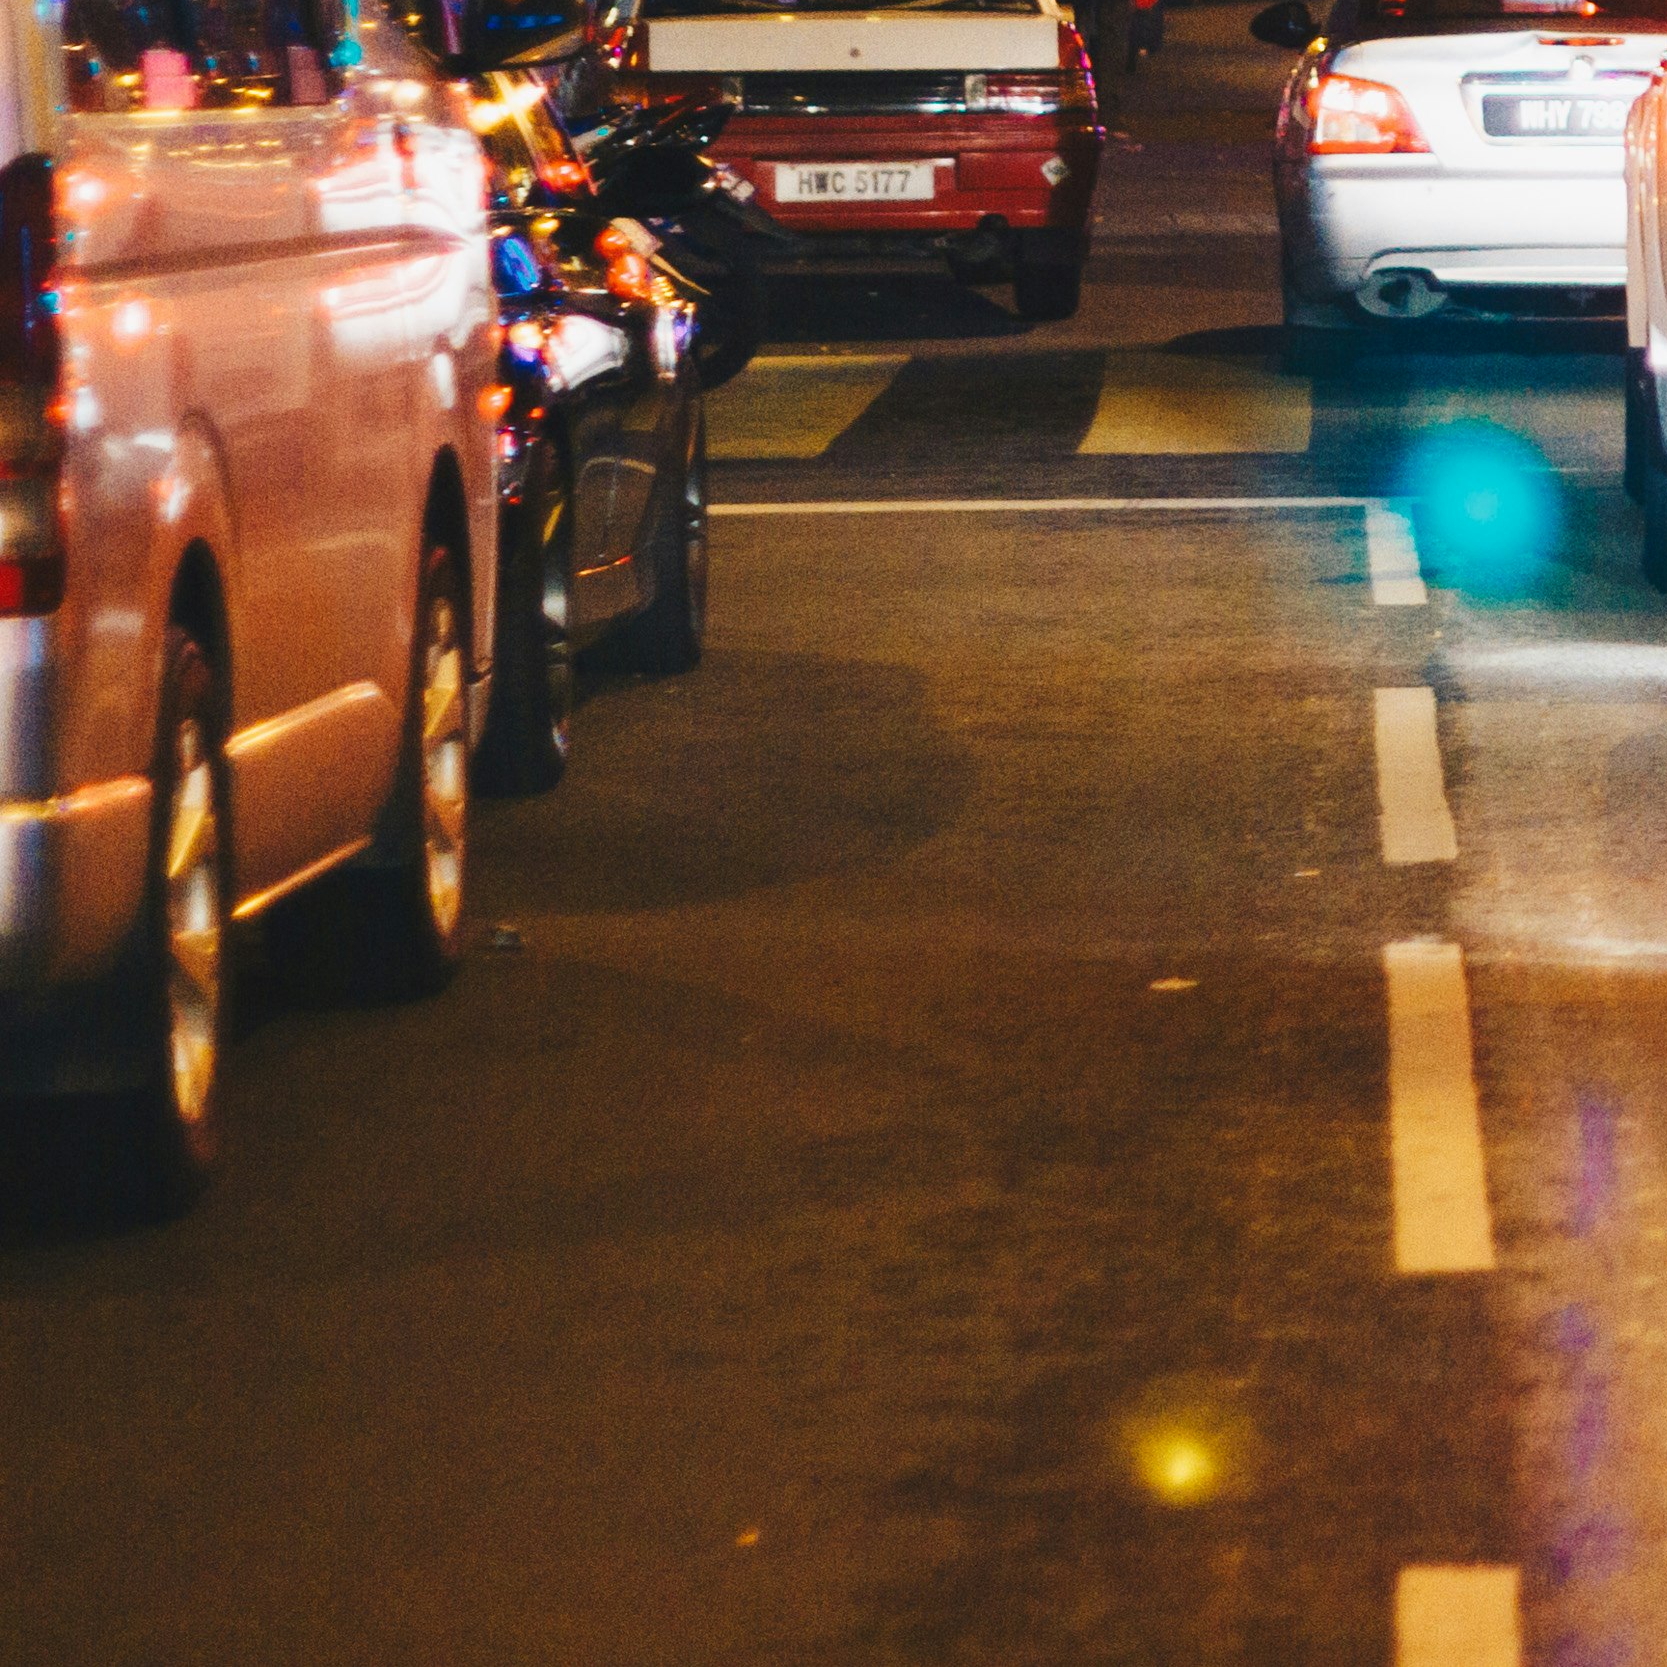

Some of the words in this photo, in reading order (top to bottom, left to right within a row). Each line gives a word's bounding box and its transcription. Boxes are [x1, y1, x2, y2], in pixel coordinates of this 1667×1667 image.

[1519, 99, 1572, 131] WHY
[798, 170, 846, 194] HWC
[855, 169, 911, 194] 5177
